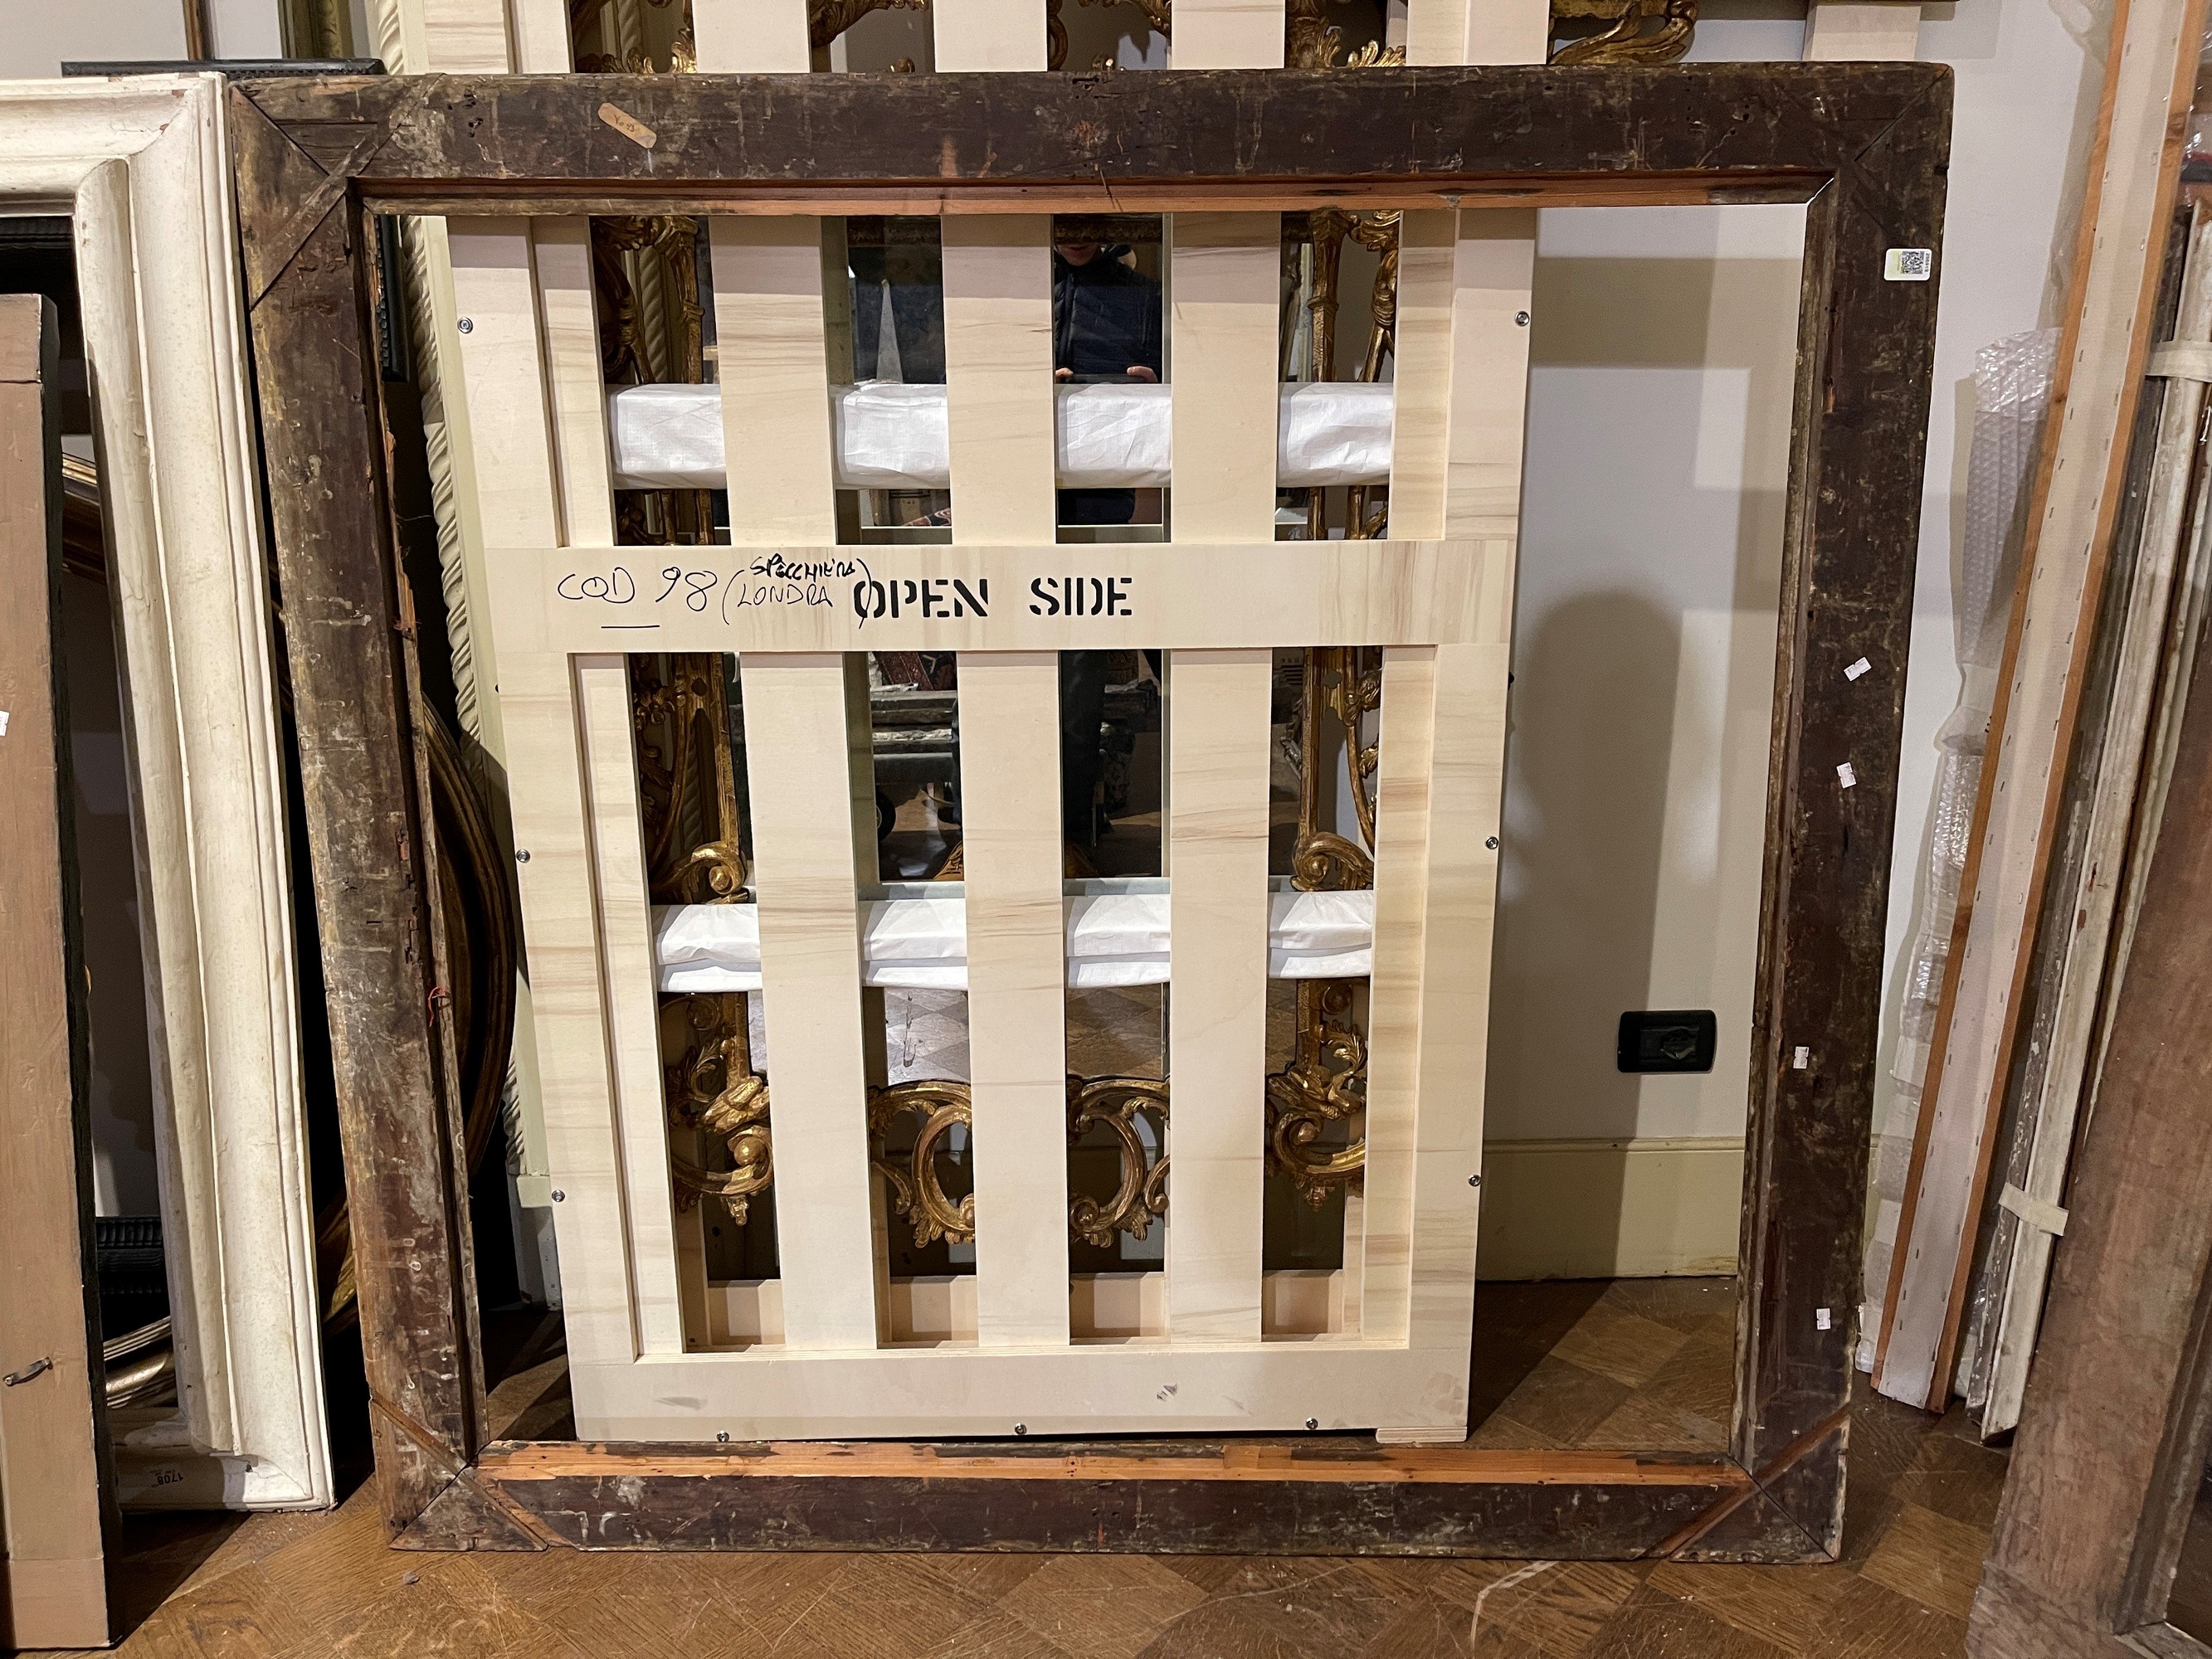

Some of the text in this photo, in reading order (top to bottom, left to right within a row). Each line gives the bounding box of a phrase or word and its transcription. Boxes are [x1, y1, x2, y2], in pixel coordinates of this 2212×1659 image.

[558, 567, 636, 604] COD
[655, 567, 719, 612] 98
[853, 577, 1133, 619] OPEN SIDE
[157, 1472, 184, 1486] 1708
